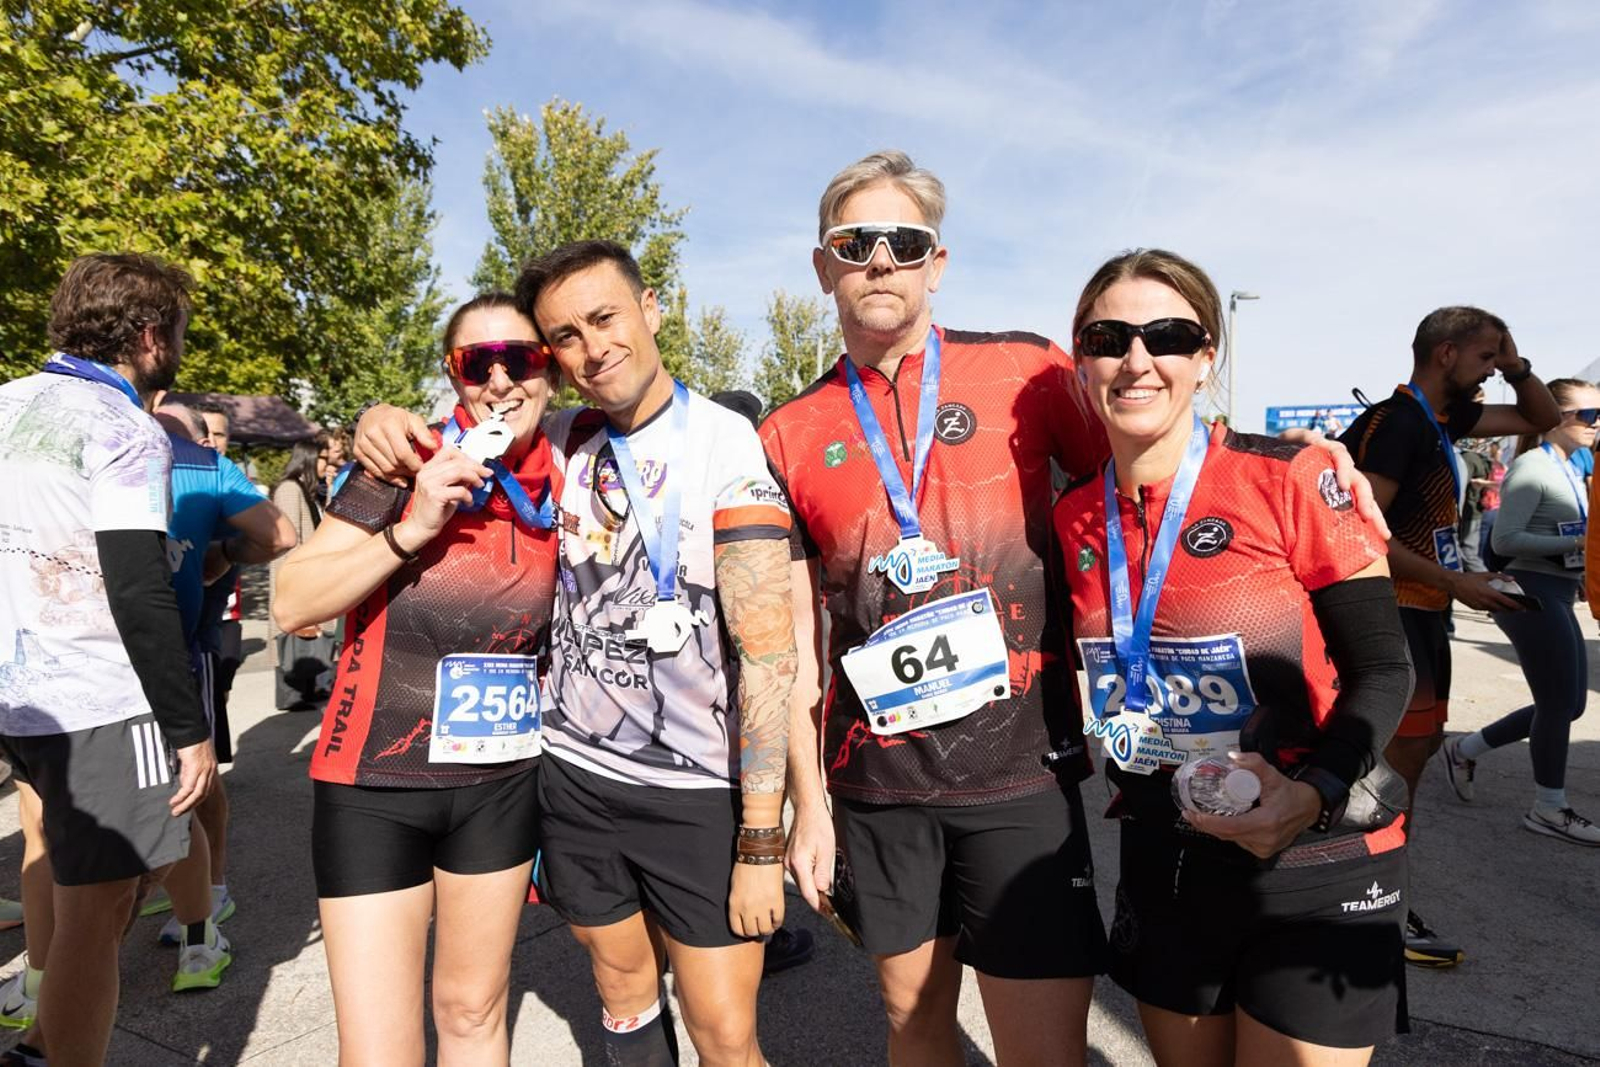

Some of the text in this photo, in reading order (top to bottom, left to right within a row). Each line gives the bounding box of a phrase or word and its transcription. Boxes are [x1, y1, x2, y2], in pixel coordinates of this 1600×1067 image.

[917, 553, 945, 564] MEDIA
[563, 618, 649, 665] LPEZ
[563, 653, 649, 690] SANCOR
[890, 633, 960, 684] 64
[913, 678, 952, 697] MANUEL
[447, 684, 539, 722] 2564
[324, 683, 358, 758] TRAIL
[1138, 736, 1171, 748] MEDIA
[1133, 757, 1158, 767] JAÉN
[1340, 889, 1401, 913] TEAMERGY
